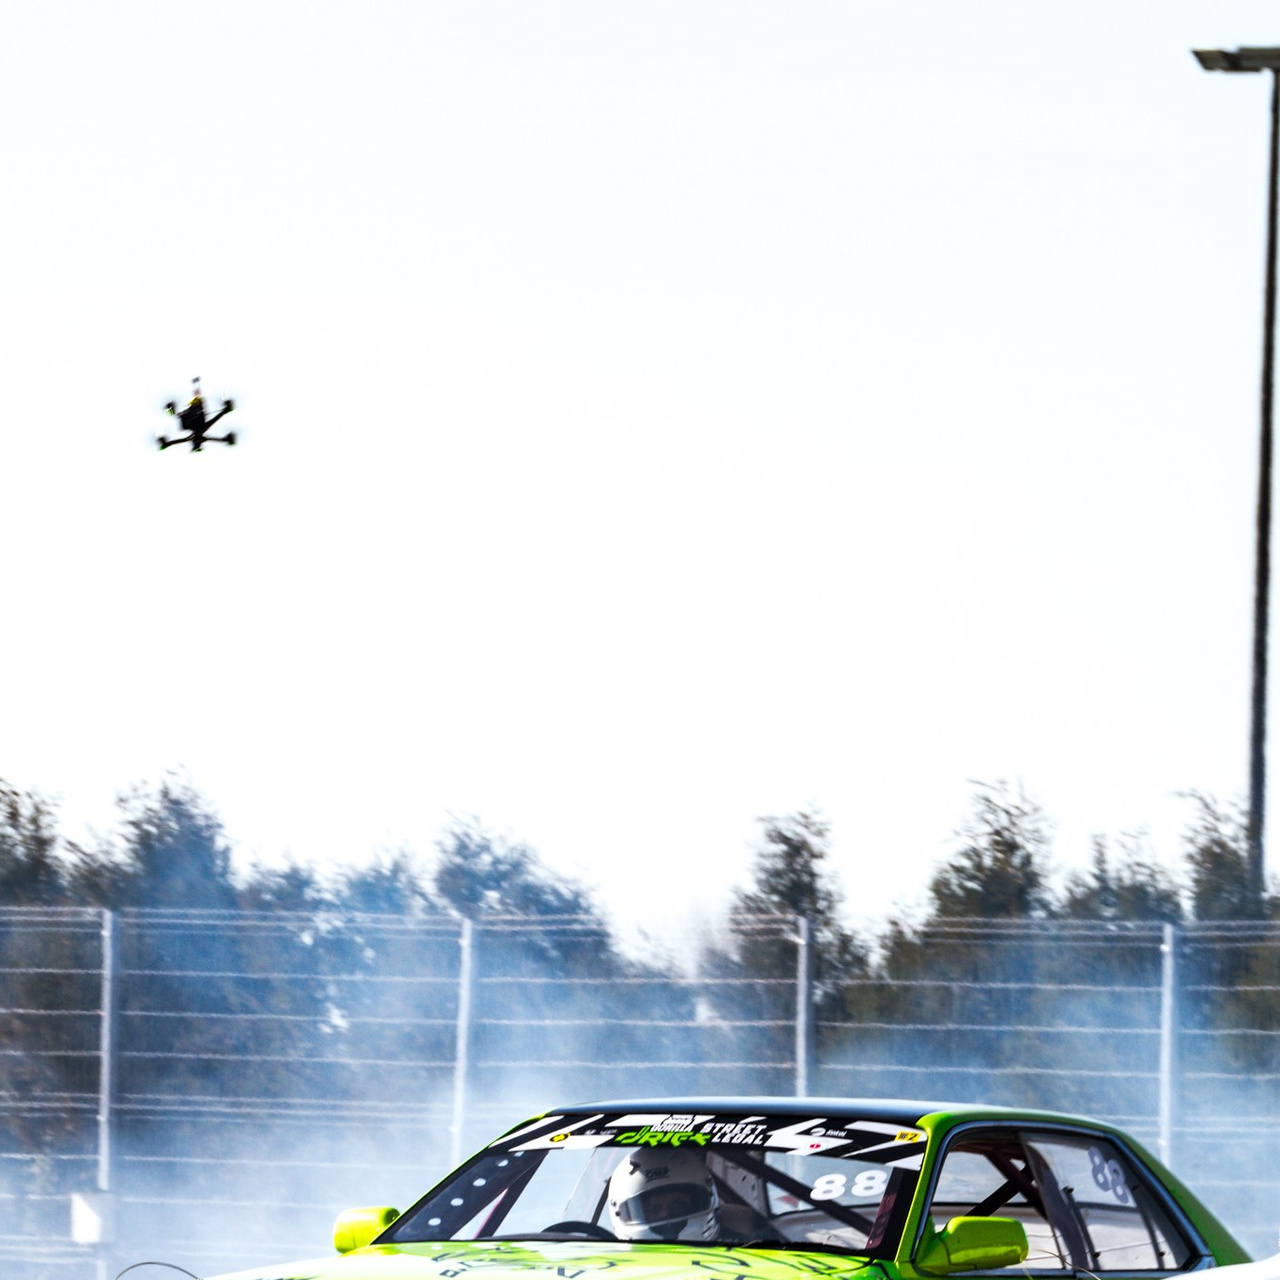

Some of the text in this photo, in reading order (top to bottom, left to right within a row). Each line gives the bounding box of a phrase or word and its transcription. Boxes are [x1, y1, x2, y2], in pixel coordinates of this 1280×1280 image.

[700, 1122, 768, 1135] STREET
[711, 1133, 766, 1145] LEGAL
[810, 1169, 888, 1201] 88
[1088, 1145, 1130, 1204] 88
